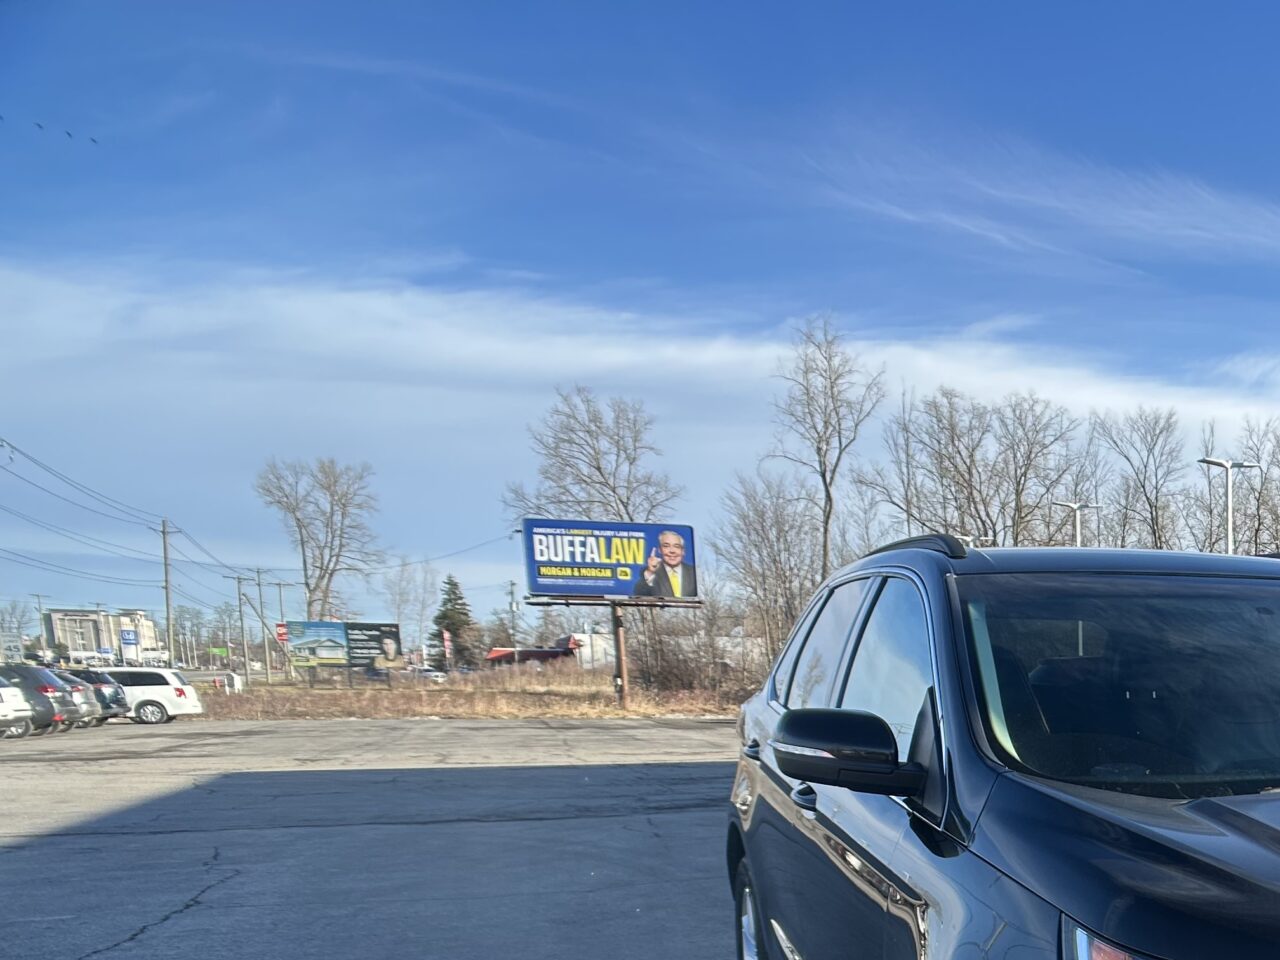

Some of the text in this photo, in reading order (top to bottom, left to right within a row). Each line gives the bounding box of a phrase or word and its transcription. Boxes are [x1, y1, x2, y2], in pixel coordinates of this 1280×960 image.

[533, 534, 644, 564] BUFFALAW
[540, 566, 612, 577] MORGAN & MORGAN
